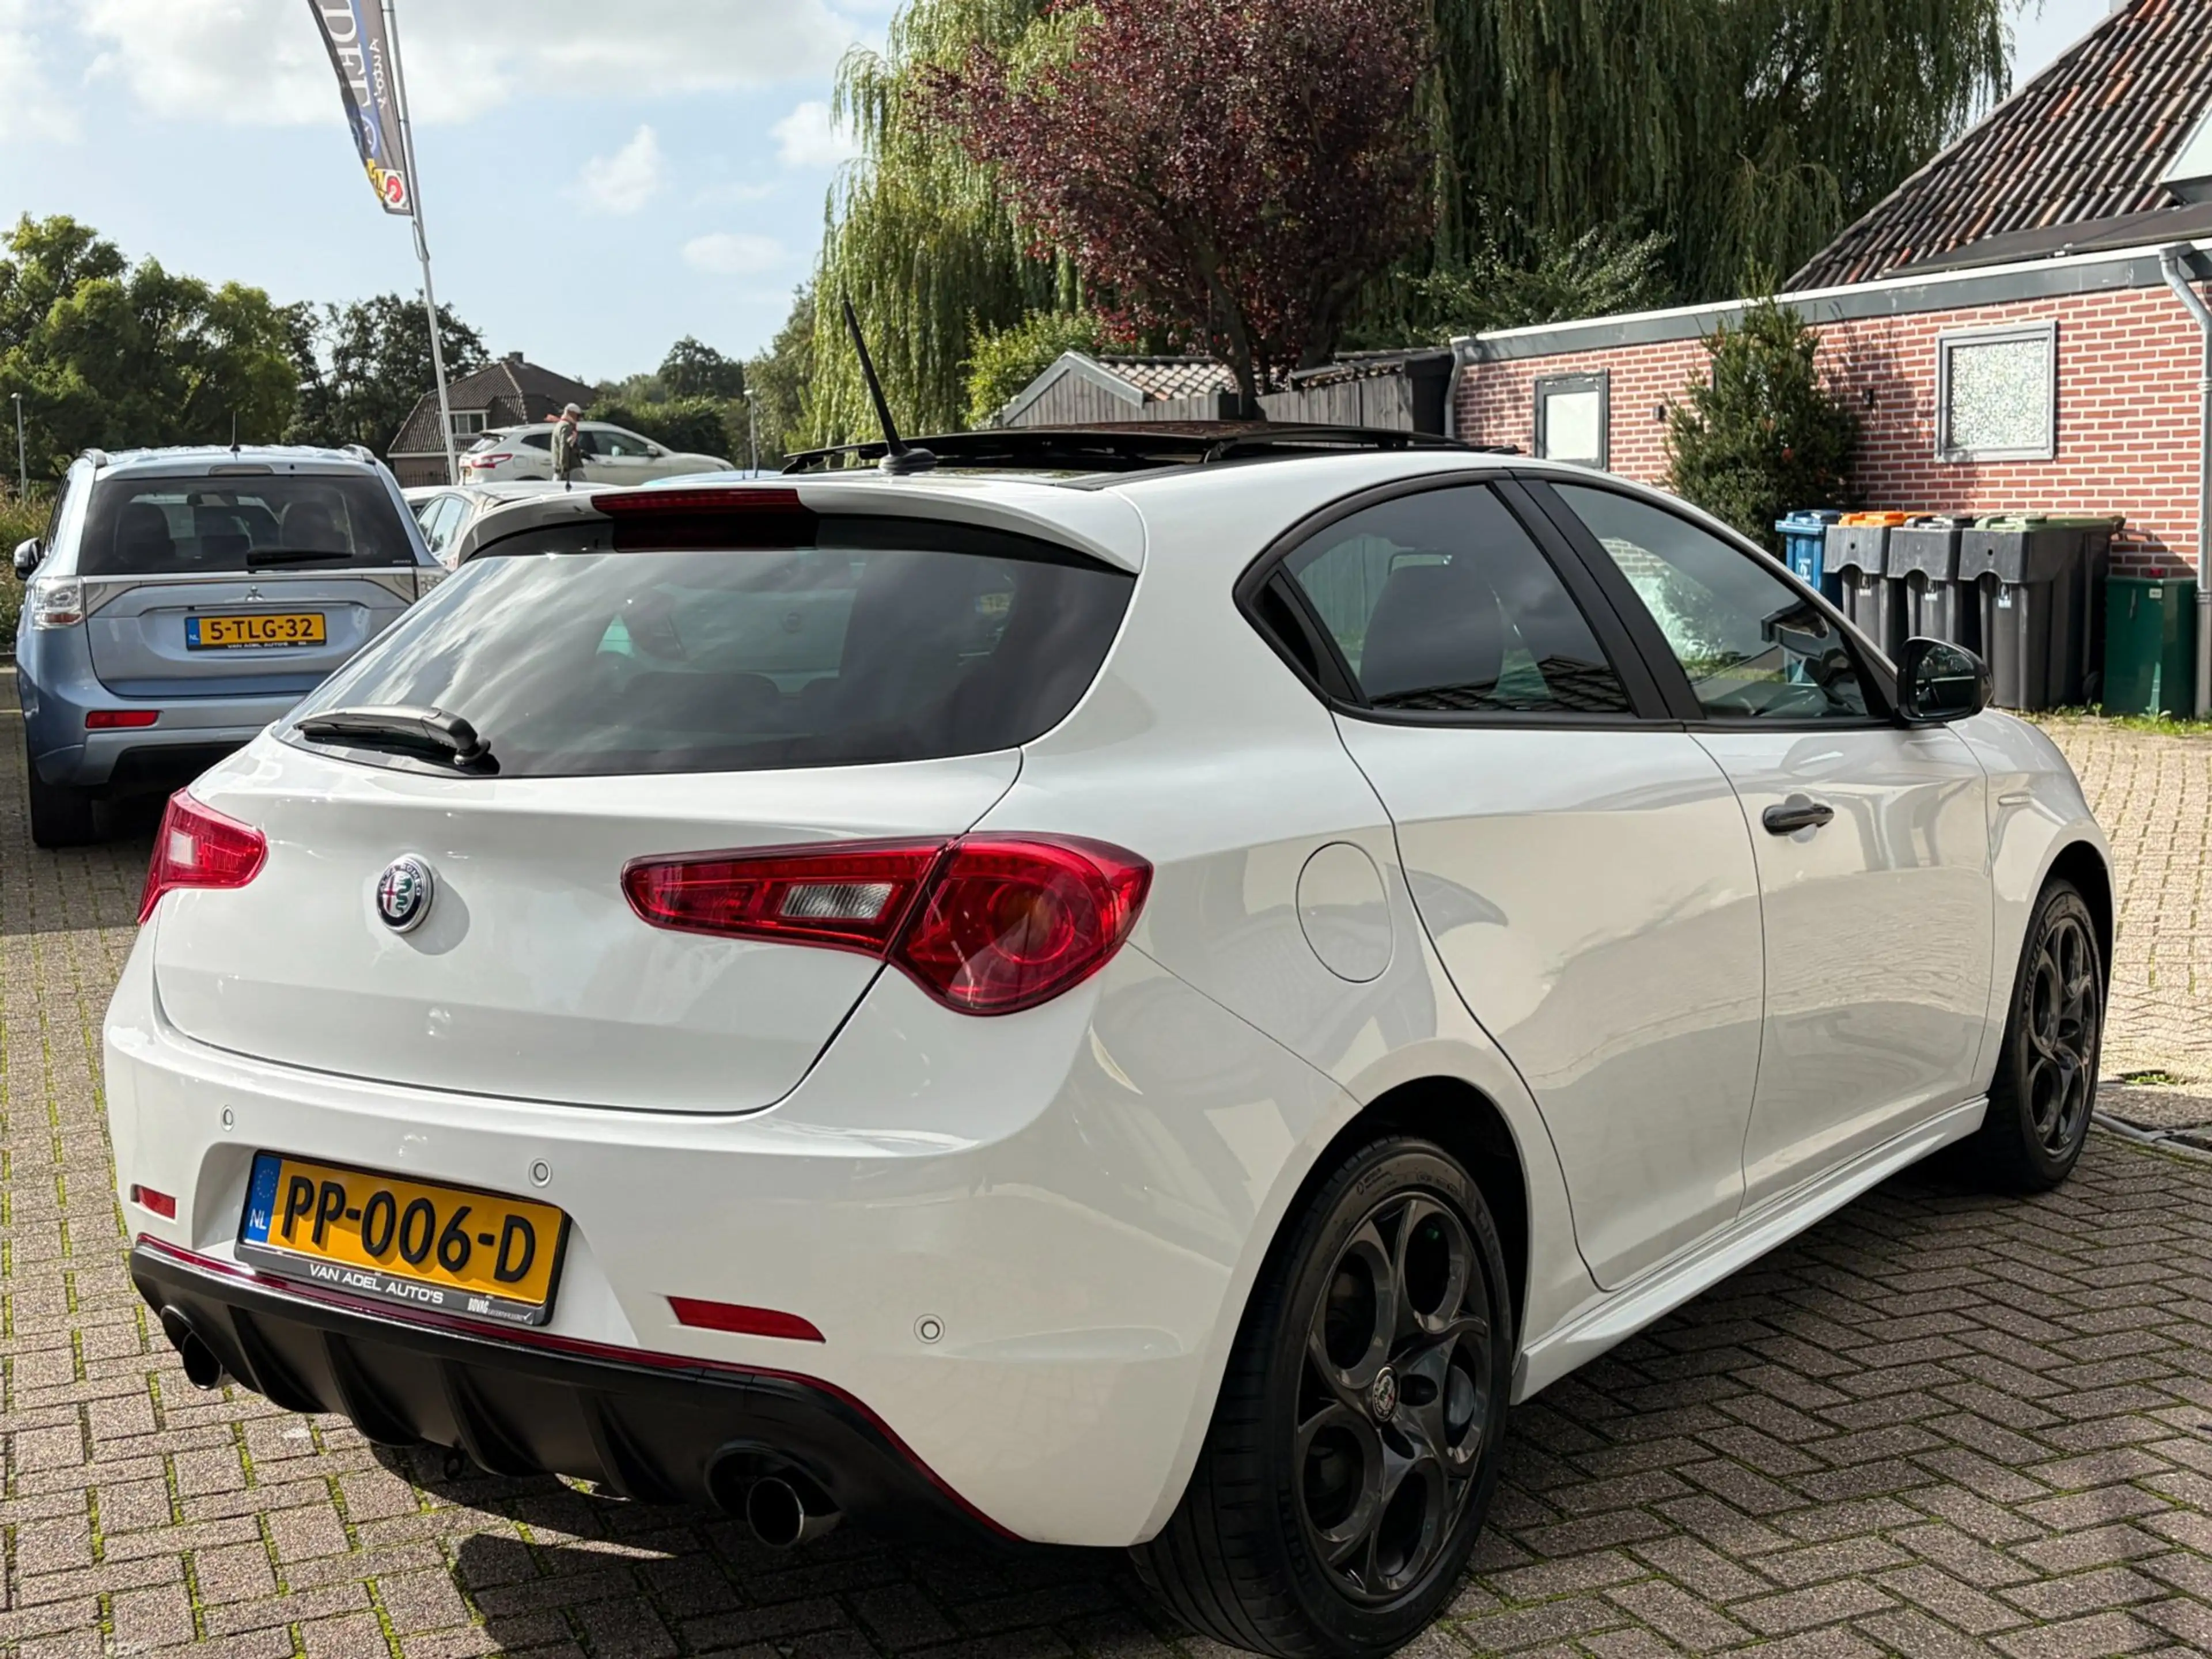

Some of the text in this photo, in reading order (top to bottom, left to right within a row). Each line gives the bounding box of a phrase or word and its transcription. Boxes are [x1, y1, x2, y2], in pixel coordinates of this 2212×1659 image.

[210, 618, 313, 641] 5-TLG-32
[401, 862, 422, 896] ROMEO
[249, 1207, 267, 1230] NL
[281, 1175, 537, 1283] PP-006-D
[309, 1263, 444, 1304] VAN ADEL AUTO'S
